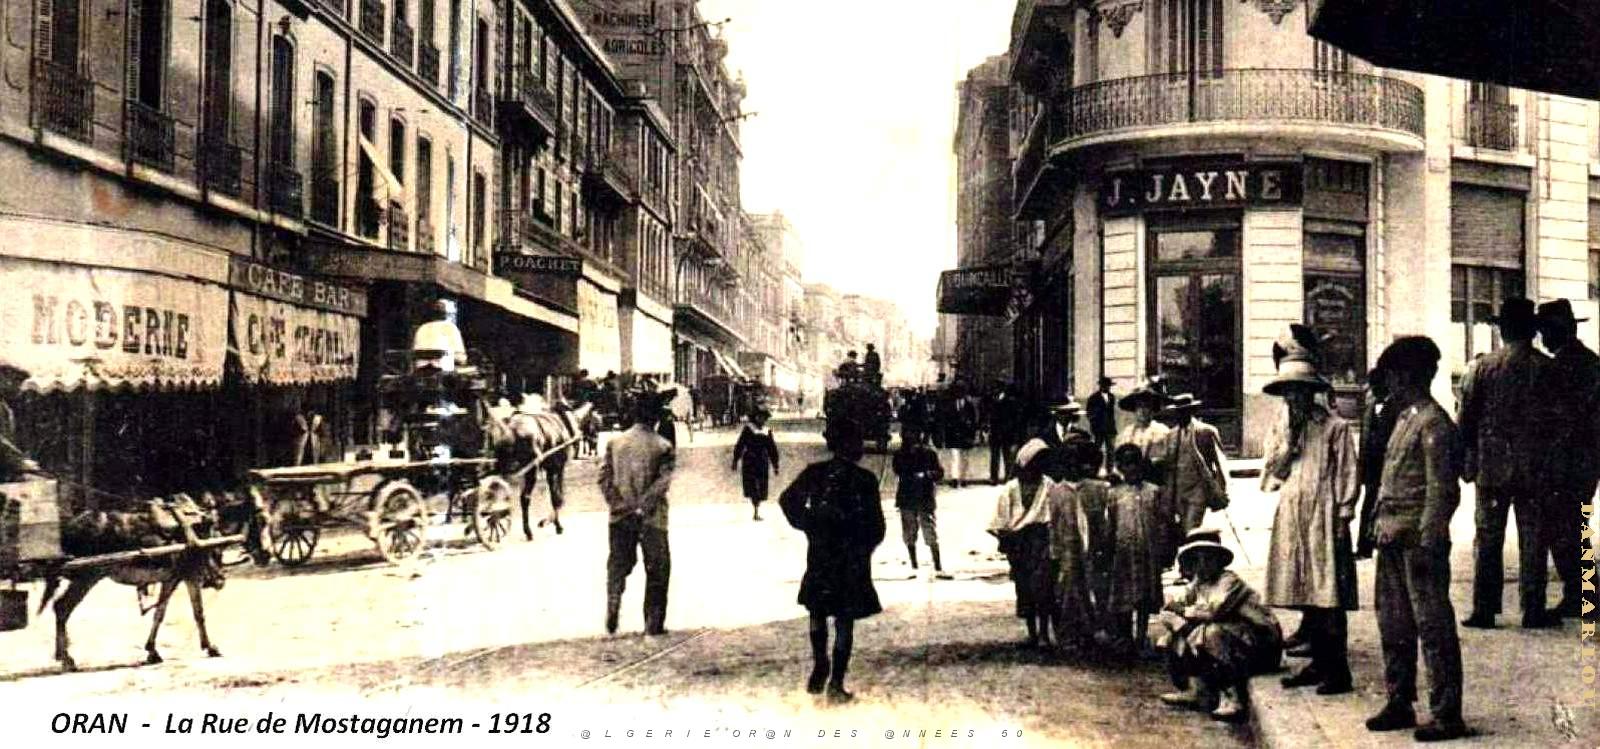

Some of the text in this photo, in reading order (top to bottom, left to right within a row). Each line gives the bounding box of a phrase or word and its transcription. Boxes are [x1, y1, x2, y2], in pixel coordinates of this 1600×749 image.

[603, 38, 666, 55] AGRICOLES
[1107, 170, 1282, 207] J. JAYNE
[314, 281, 349, 309] BAR
[31, 293, 190, 360] MODERNE
